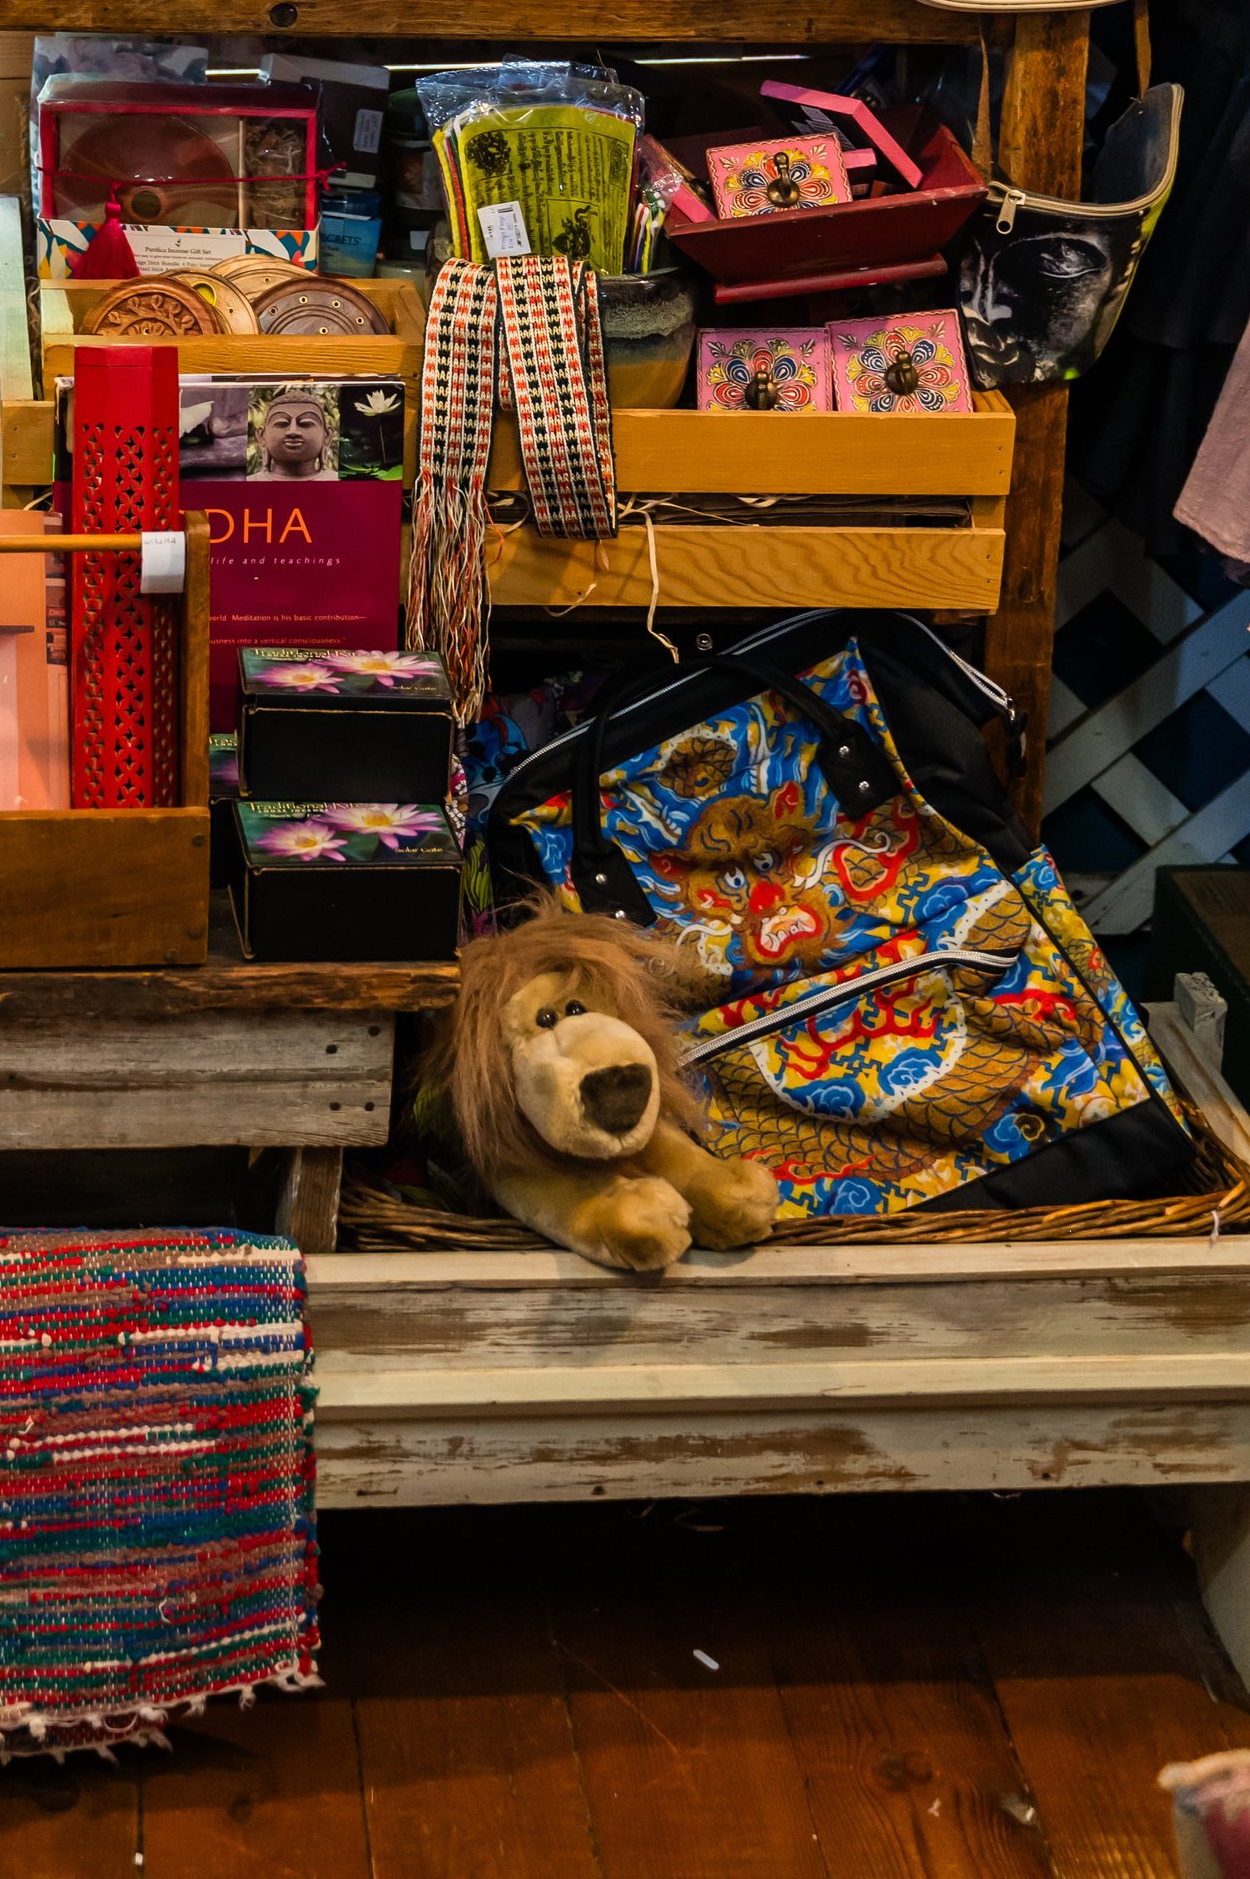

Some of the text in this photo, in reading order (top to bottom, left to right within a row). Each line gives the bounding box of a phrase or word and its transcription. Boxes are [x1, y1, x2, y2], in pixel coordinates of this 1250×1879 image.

[210, 556, 341, 567] life and teachings
[231, 613, 271, 622] Meditation
[281, 613, 292, 622] his
[293, 613, 312, 622] basic
[236, 636, 251, 645] into
[260, 635, 286, 645] vertical
[254, 648, 332, 658] Traditional
[249, 801, 328, 811] Traditional
